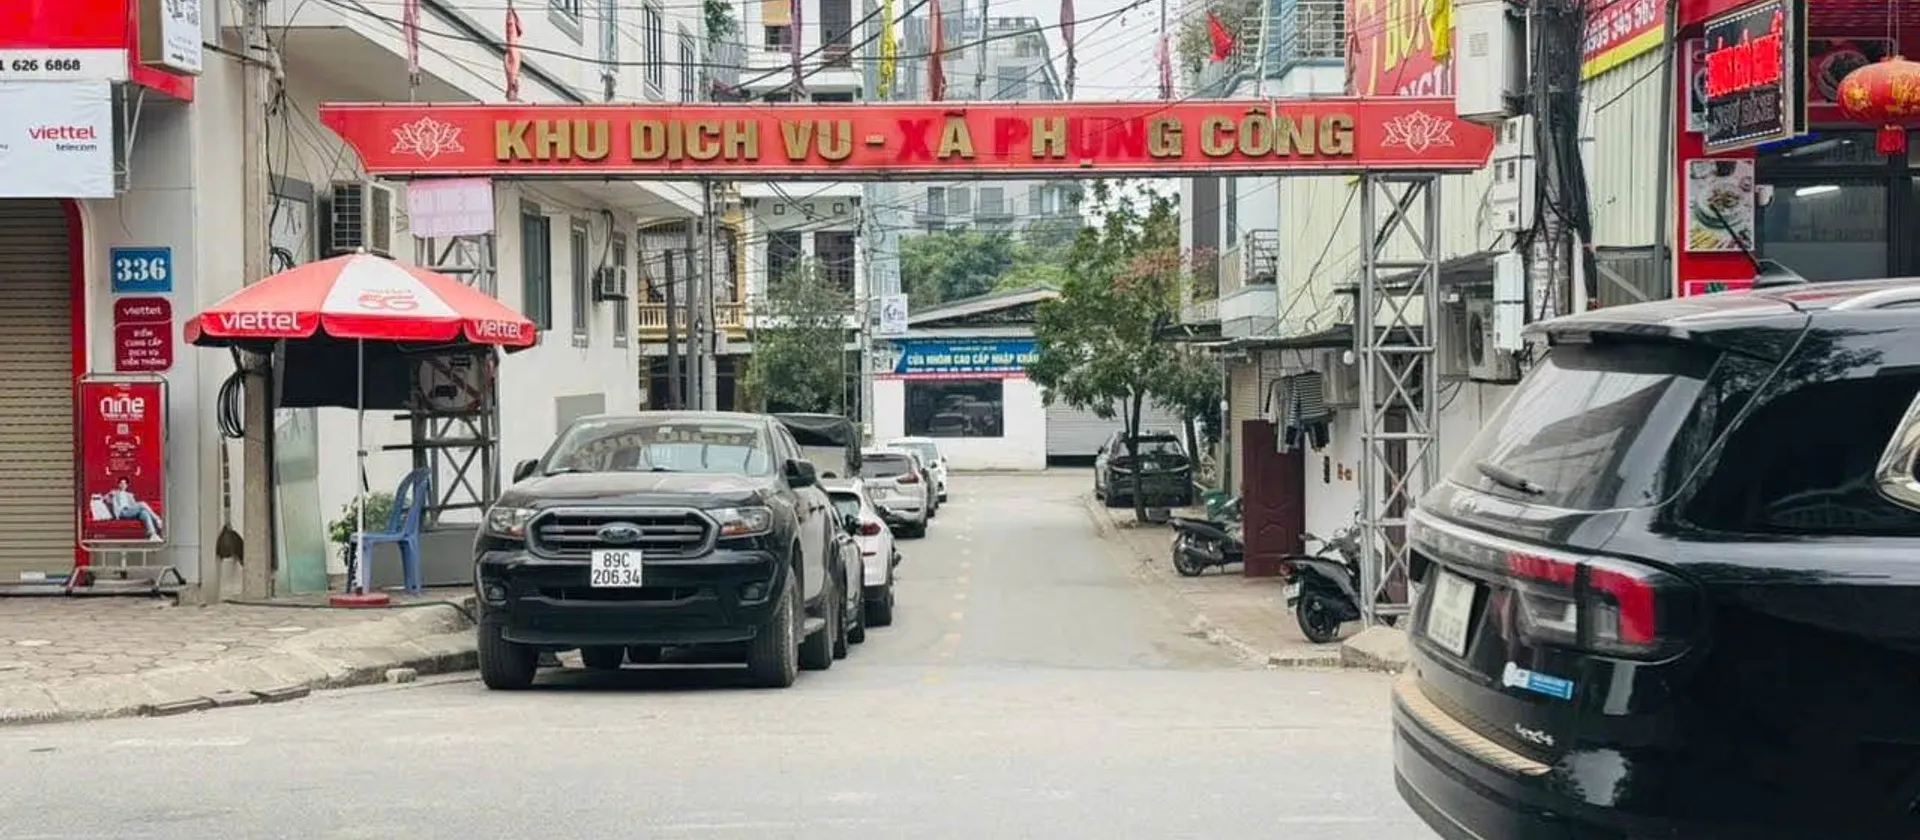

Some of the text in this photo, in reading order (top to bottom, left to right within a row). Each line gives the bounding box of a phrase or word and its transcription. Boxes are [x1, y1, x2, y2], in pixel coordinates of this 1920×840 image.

[12, 59, 38, 71] 626
[45, 59, 81, 71] 6868
[29, 125, 97, 140] viettel
[495, 119, 609, 161] KHU
[1201, 107, 1354, 156] CÔNG
[56, 142, 97, 151] telecom
[116, 258, 166, 282] 336
[124, 306, 162, 315] viettel
[219, 309, 301, 331] viettel
[474, 317, 523, 338] viettel
[953, 353, 971, 365] CAO
[603, 552, 630, 568] 89C
[593, 568, 640, 585] 206.34
